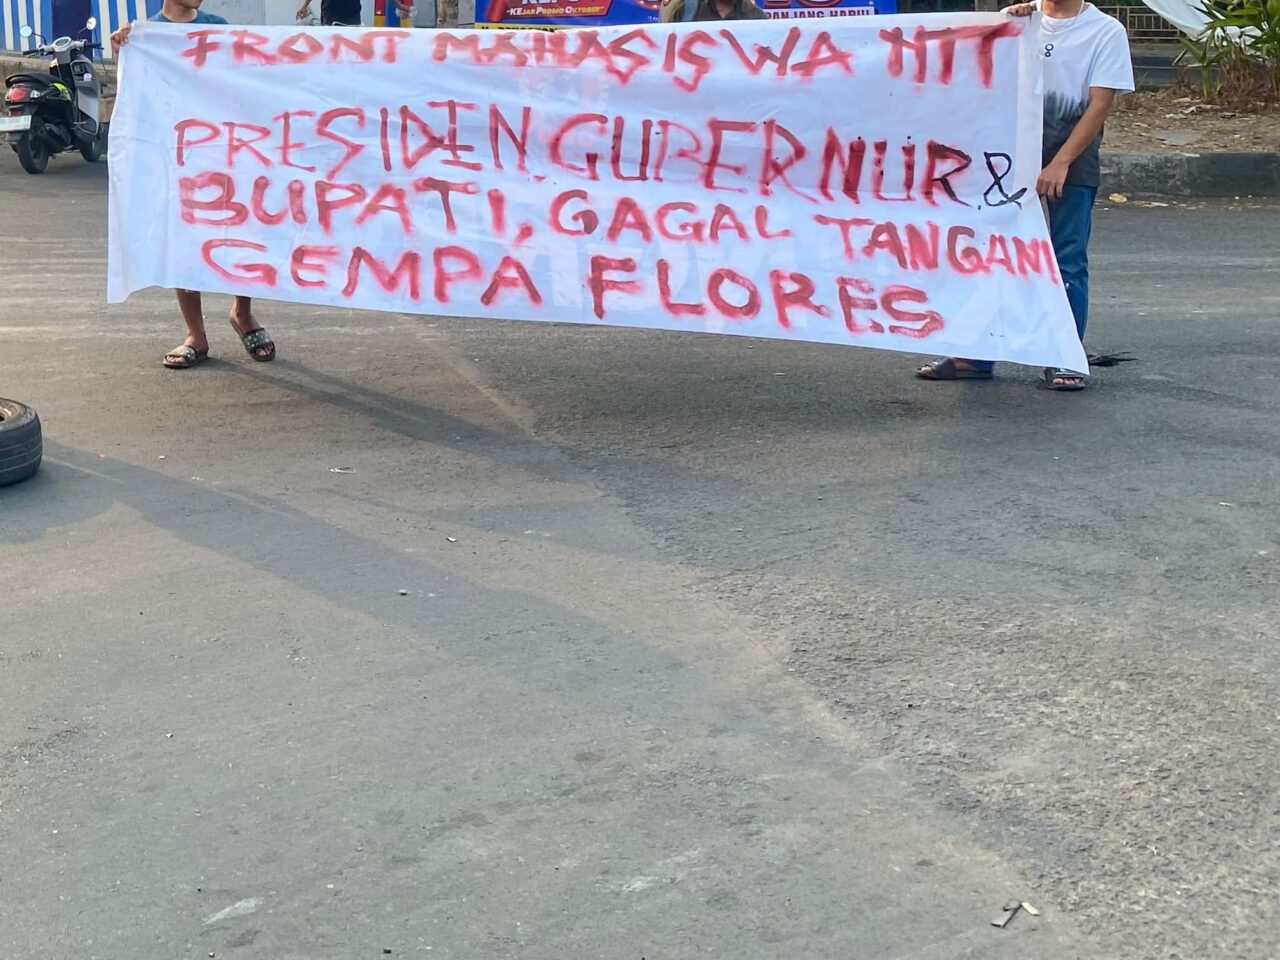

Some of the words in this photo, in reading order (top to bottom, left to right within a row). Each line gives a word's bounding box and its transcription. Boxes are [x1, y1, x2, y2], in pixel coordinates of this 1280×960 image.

[182, 28, 411, 68] FRONT
[431, 25, 854, 92] MAHASISWA
[547, 189, 792, 243] GAGAL
[200, 237, 543, 308] GEMPA
[586, 255, 946, 338] FLORES
